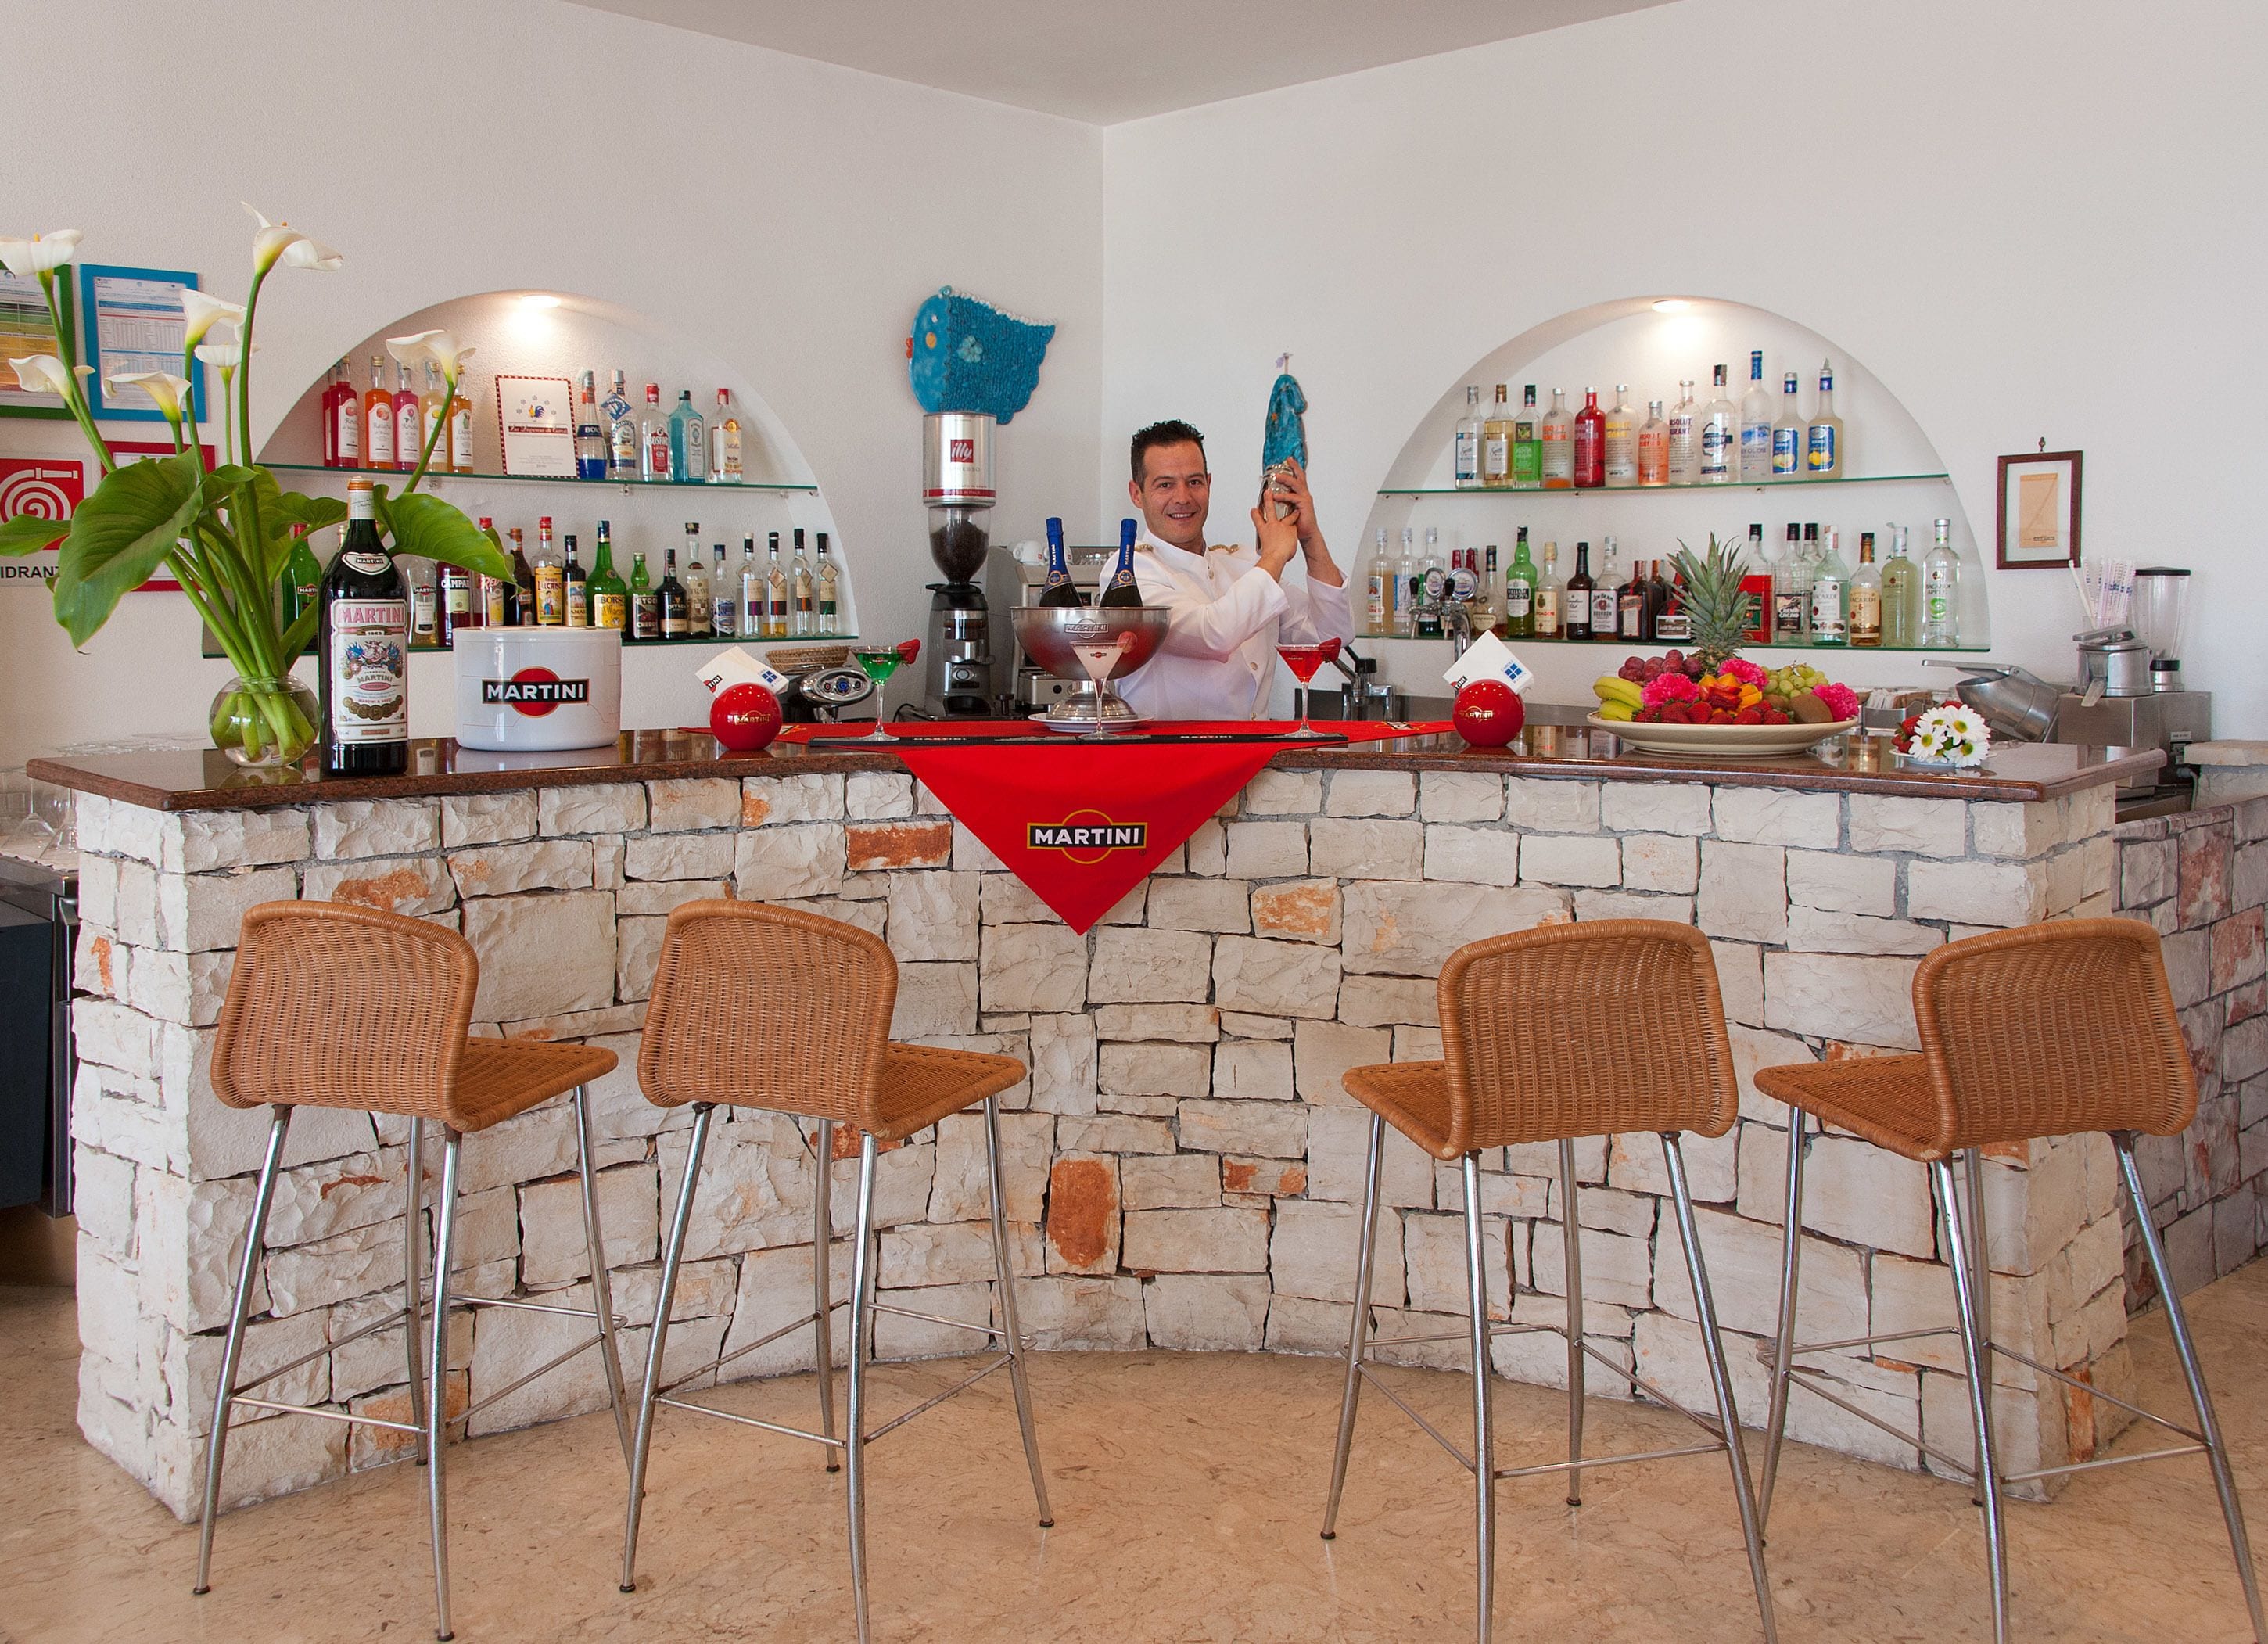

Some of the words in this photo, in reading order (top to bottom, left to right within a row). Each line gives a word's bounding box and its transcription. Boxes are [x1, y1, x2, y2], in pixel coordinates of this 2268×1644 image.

[951, 442, 973, 461] illy
[1, 565, 59, 579] IDRAN
[337, 607, 405, 623] MARTINI
[357, 674, 393, 684] MARTINI
[487, 684, 583, 700] MARTINI
[1035, 827, 1139, 845] MARTINI
